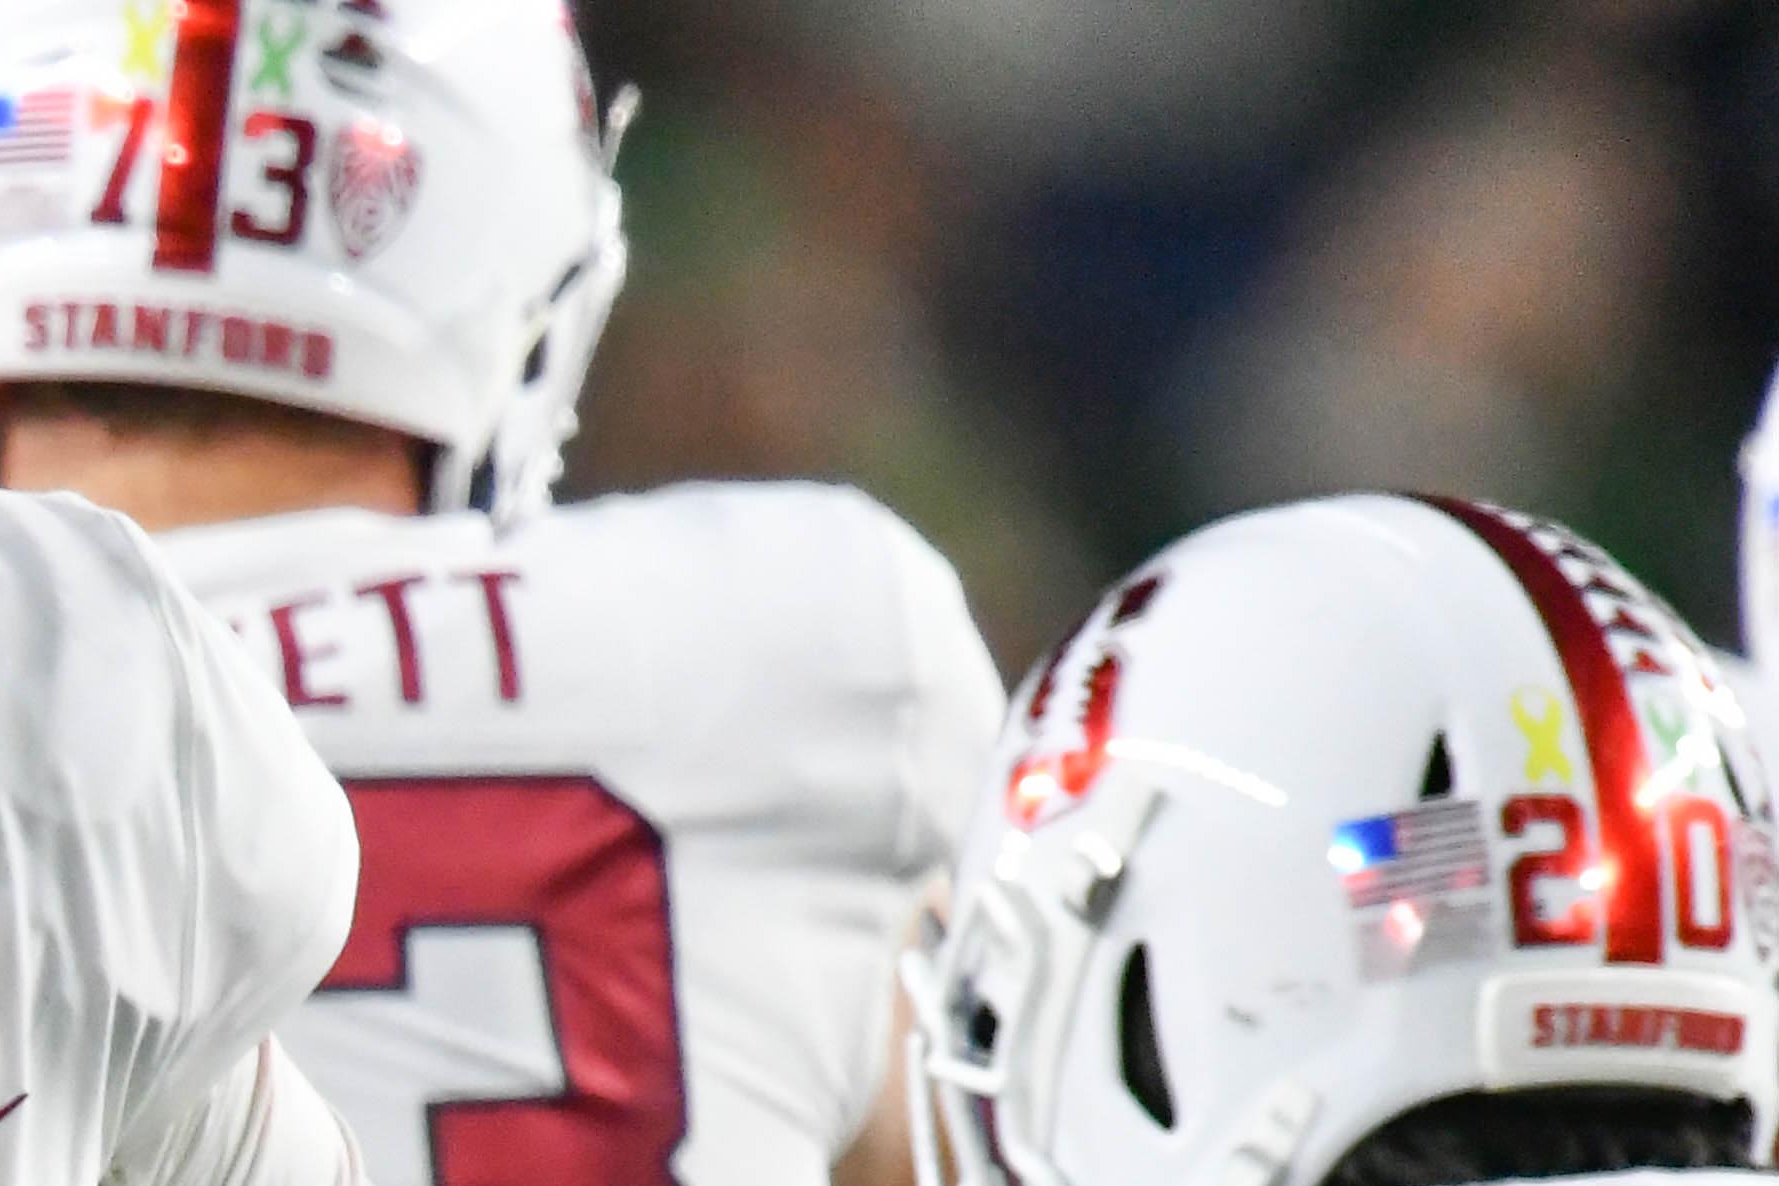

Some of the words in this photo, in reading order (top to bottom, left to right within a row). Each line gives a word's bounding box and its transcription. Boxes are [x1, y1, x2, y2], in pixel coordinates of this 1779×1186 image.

[23, 301, 333, 380] STANFORD
[229, 570, 522, 707] ETT
[1531, 1003, 1745, 1055] STANFORD
